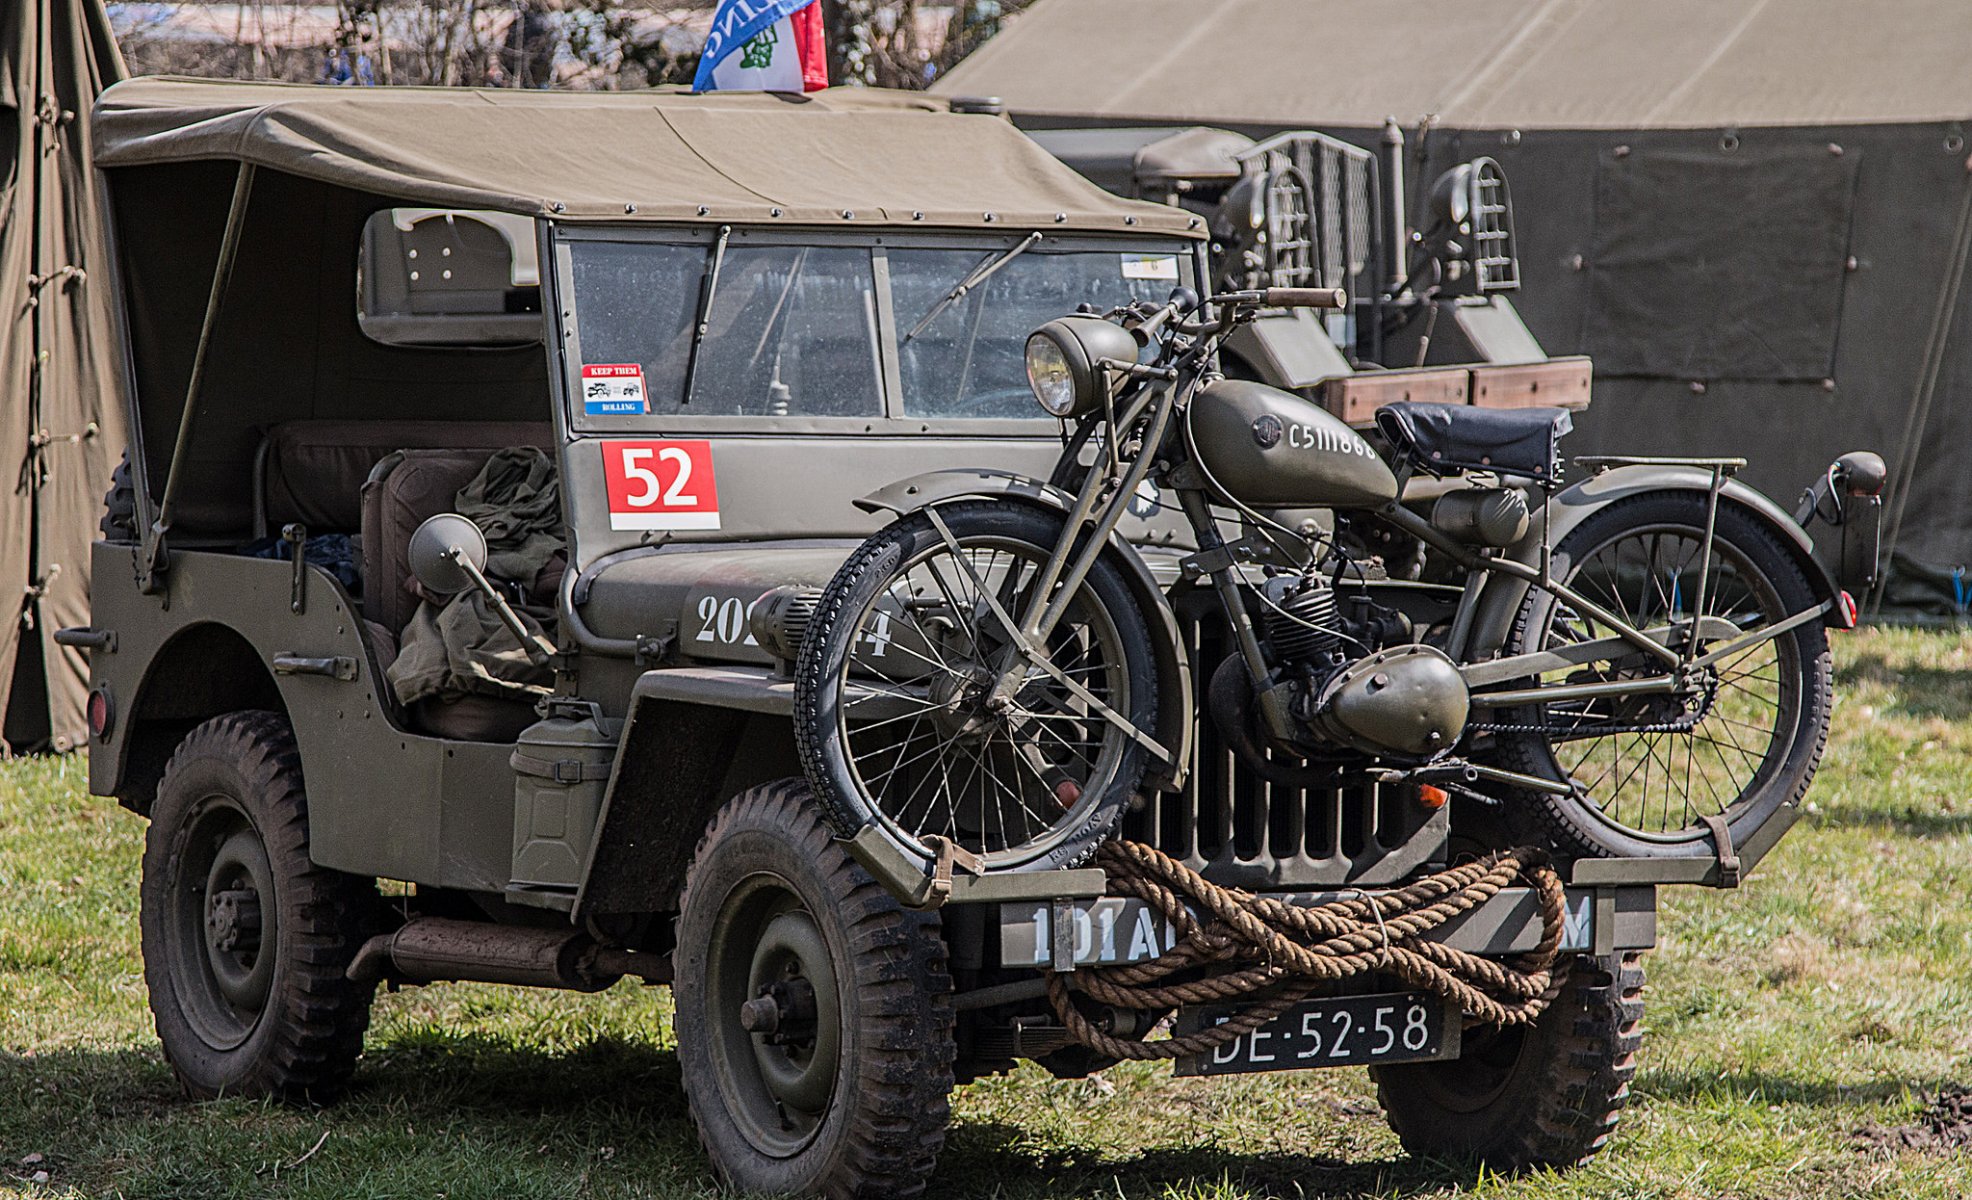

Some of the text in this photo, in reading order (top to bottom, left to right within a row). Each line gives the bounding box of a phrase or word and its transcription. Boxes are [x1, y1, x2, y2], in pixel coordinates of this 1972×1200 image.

[591, 367, 637, 376] KEEP THEM
[602, 403, 636, 411] ROLLING
[621, 447, 698, 507] 52
